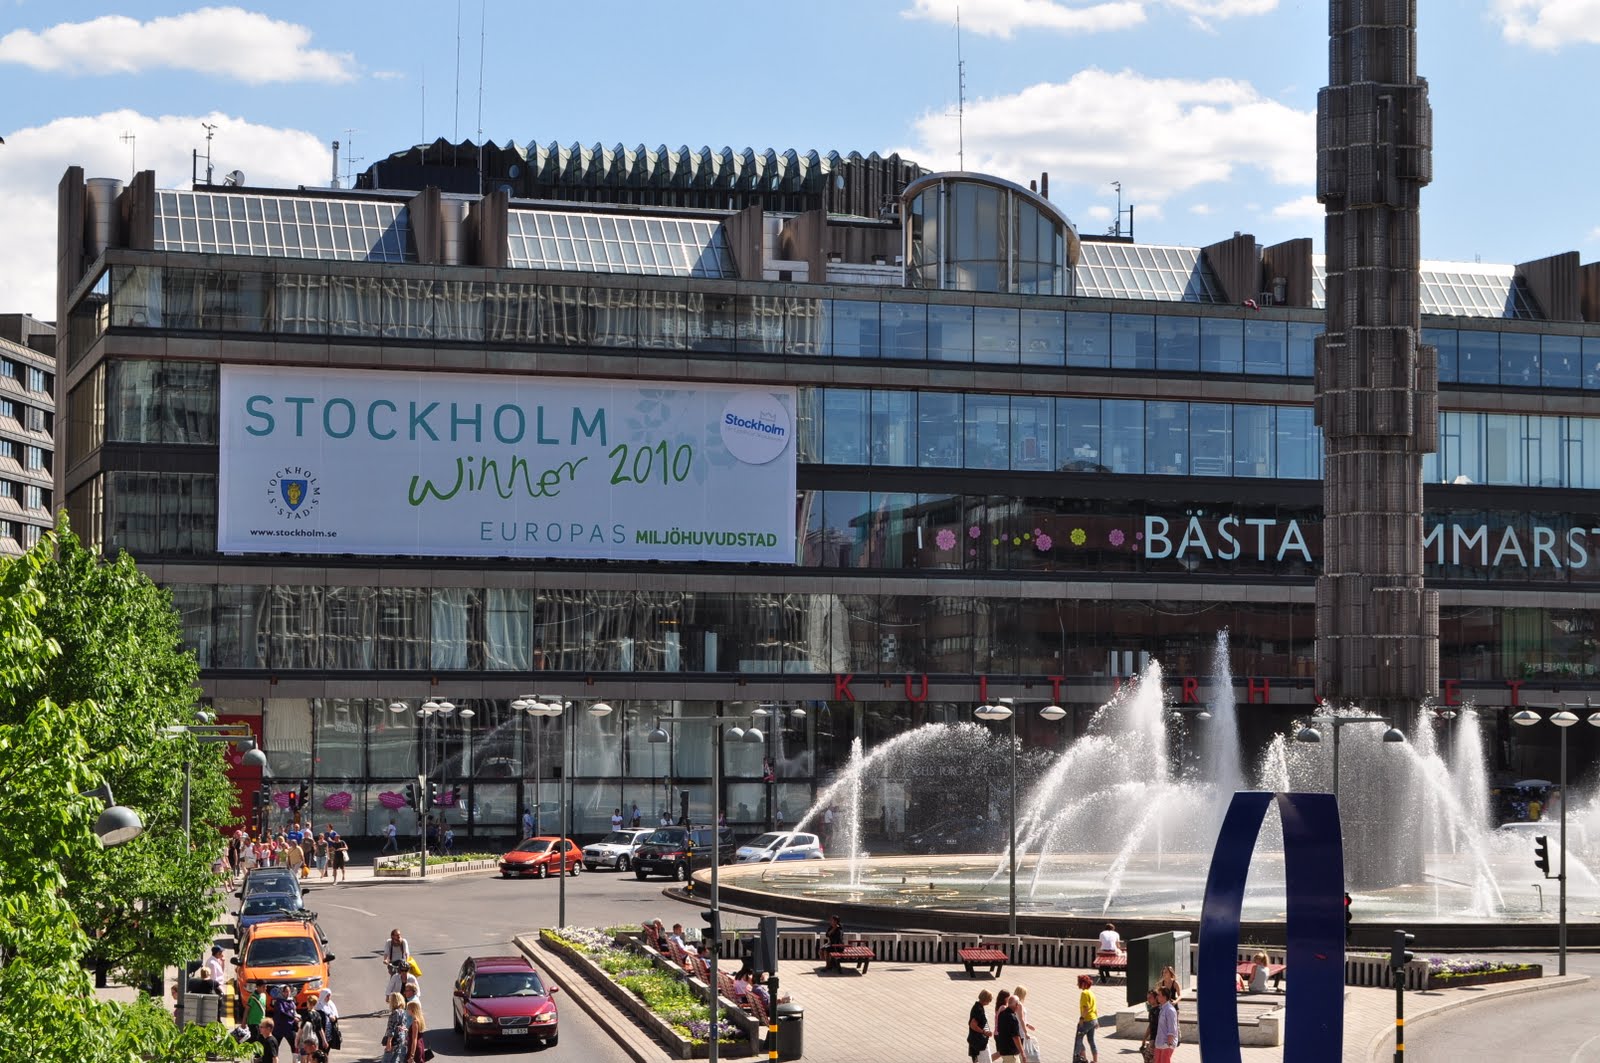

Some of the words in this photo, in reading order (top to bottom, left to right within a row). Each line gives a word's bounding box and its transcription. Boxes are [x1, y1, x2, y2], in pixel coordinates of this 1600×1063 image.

[245, 394, 607, 447] STOCKHOLM
[725, 413, 785, 436] Stockholm
[267, 466, 321, 505] STOCKHOLMS
[408, 454, 588, 506] winner
[608, 439, 693, 485] 2010
[277, 507, 311, 520] STAD
[250, 529, 338, 538] www.stockholm.se
[480, 521, 626, 544] EUROPAS
[635, 527, 777, 548] MILJÖHUVUDSTAD
[1144, 509, 1312, 562] BÄSTA
[1423, 523, 1600, 569] MMARS
